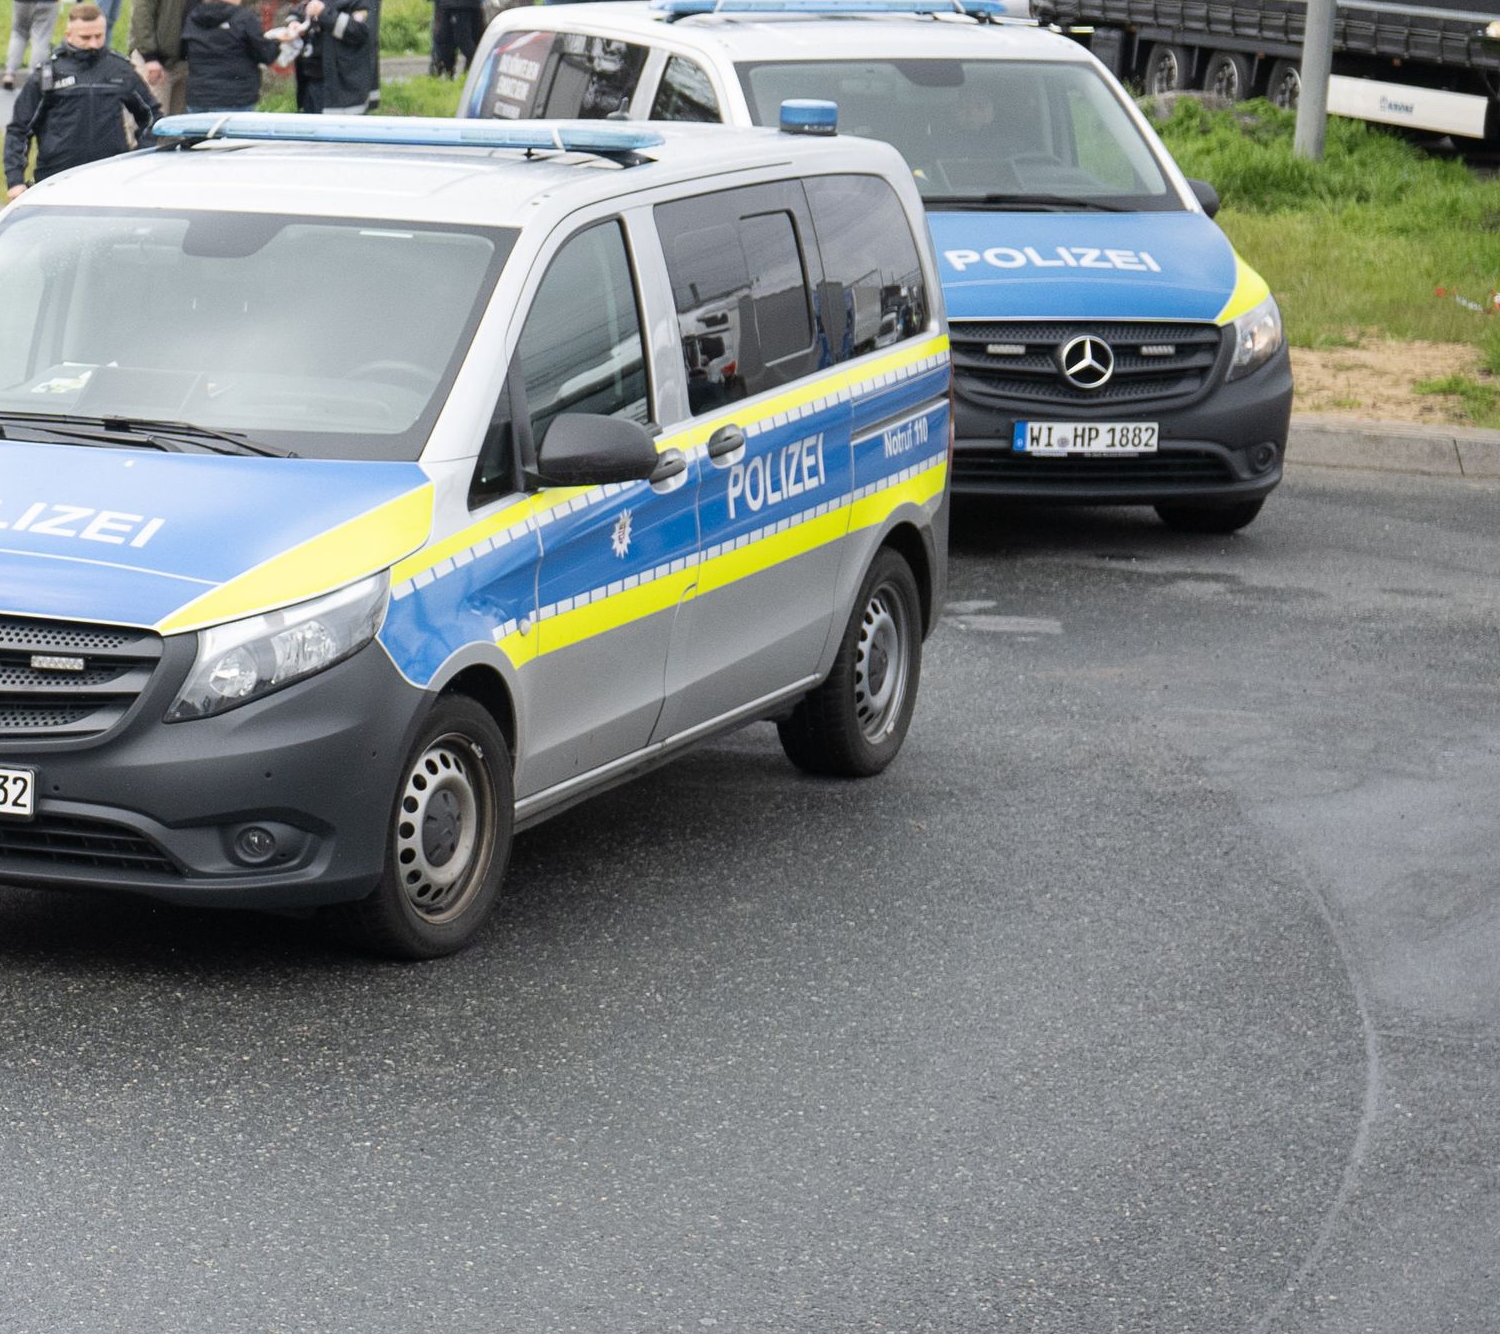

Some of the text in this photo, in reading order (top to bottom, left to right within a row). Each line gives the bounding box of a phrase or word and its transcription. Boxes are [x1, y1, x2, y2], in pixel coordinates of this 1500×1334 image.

[944, 246, 1161, 272] POLIZEI
[884, 416, 928, 458] Notruf 110
[1030, 427, 1156, 448] WI HP 1882
[727, 432, 826, 520] POLIZEI
